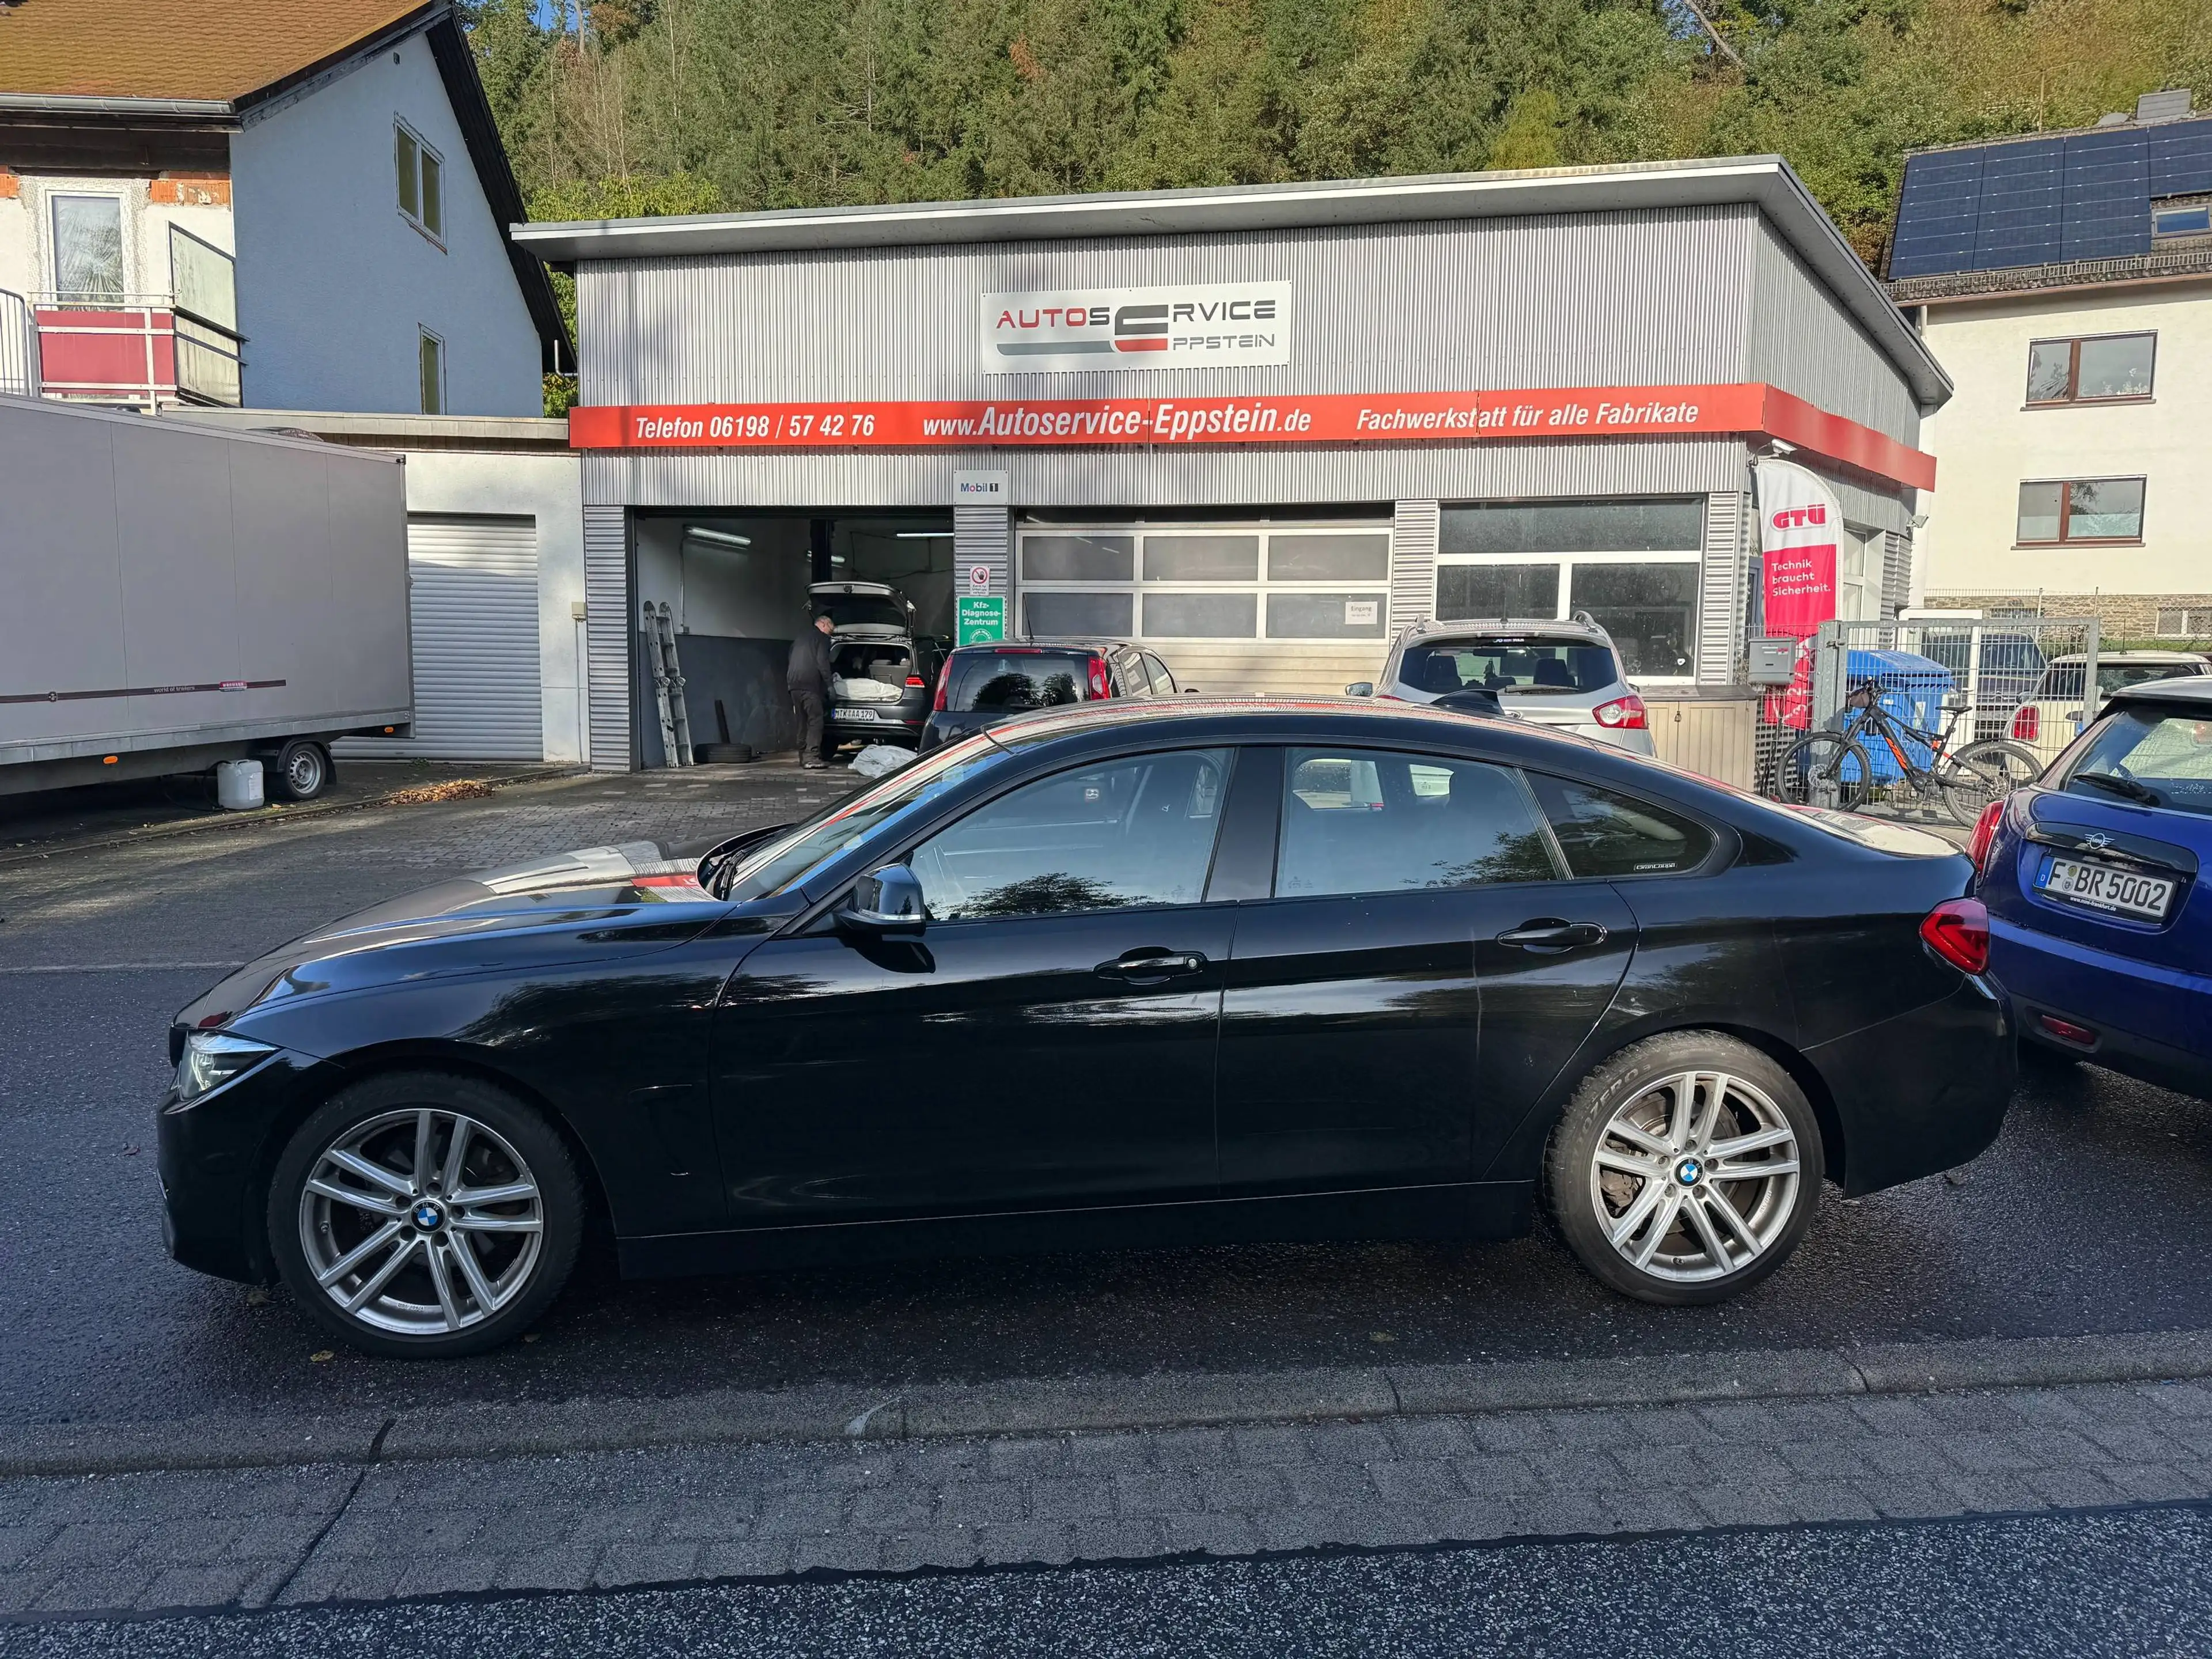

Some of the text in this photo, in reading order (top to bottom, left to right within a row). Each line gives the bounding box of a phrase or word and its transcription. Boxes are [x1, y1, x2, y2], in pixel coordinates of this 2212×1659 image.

[923, 403, 1311, 441] www.Autoservice-Eppstein.de
[1357, 402, 1699, 431] Fachwerkstatt für alle Fabrikate
[636, 414, 874, 439] Telefon 06198 / 57 42 76
[961, 483, 998, 492] Mobil 1
[1773, 503, 1826, 529] GTÜ
[1771, 559, 1812, 571] Technik
[1772, 571, 1815, 585] braucht
[1772, 583, 1831, 597] Sicherheit.
[961, 609, 1002, 618] Diagnose-
[2048, 861, 2166, 911] F BR 5002
